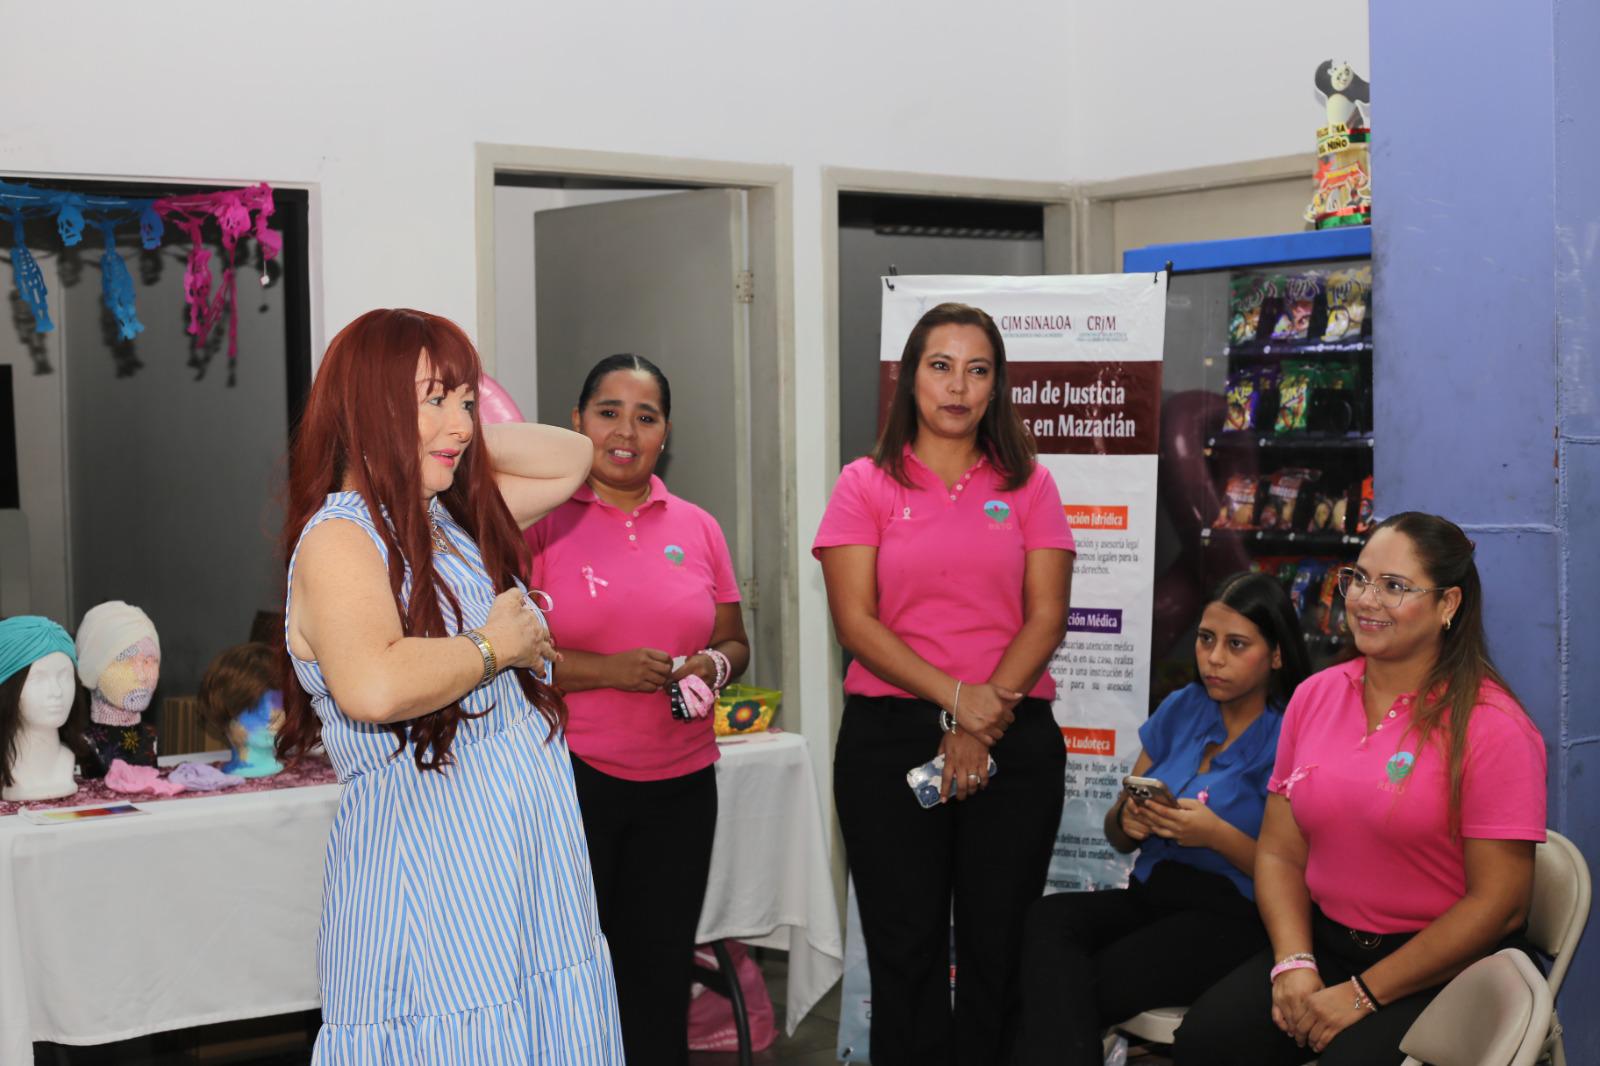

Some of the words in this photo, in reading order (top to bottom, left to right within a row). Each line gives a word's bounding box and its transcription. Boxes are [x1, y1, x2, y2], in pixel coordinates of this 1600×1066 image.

[1001, 315, 1021, 333] CJM
[1024, 315, 1072, 331] SINALOA
[1040, 380, 1060, 404] de
[1063, 380, 1125, 408] Justicia
[1033, 418, 1054, 437] en
[1058, 412, 1135, 437] Mazatlán
[1067, 511, 1090, 526] nción
[1067, 613, 1086, 626] ción
[1086, 612, 1118, 628] Médica
[1072, 736, 1110, 751] Ludoteca
